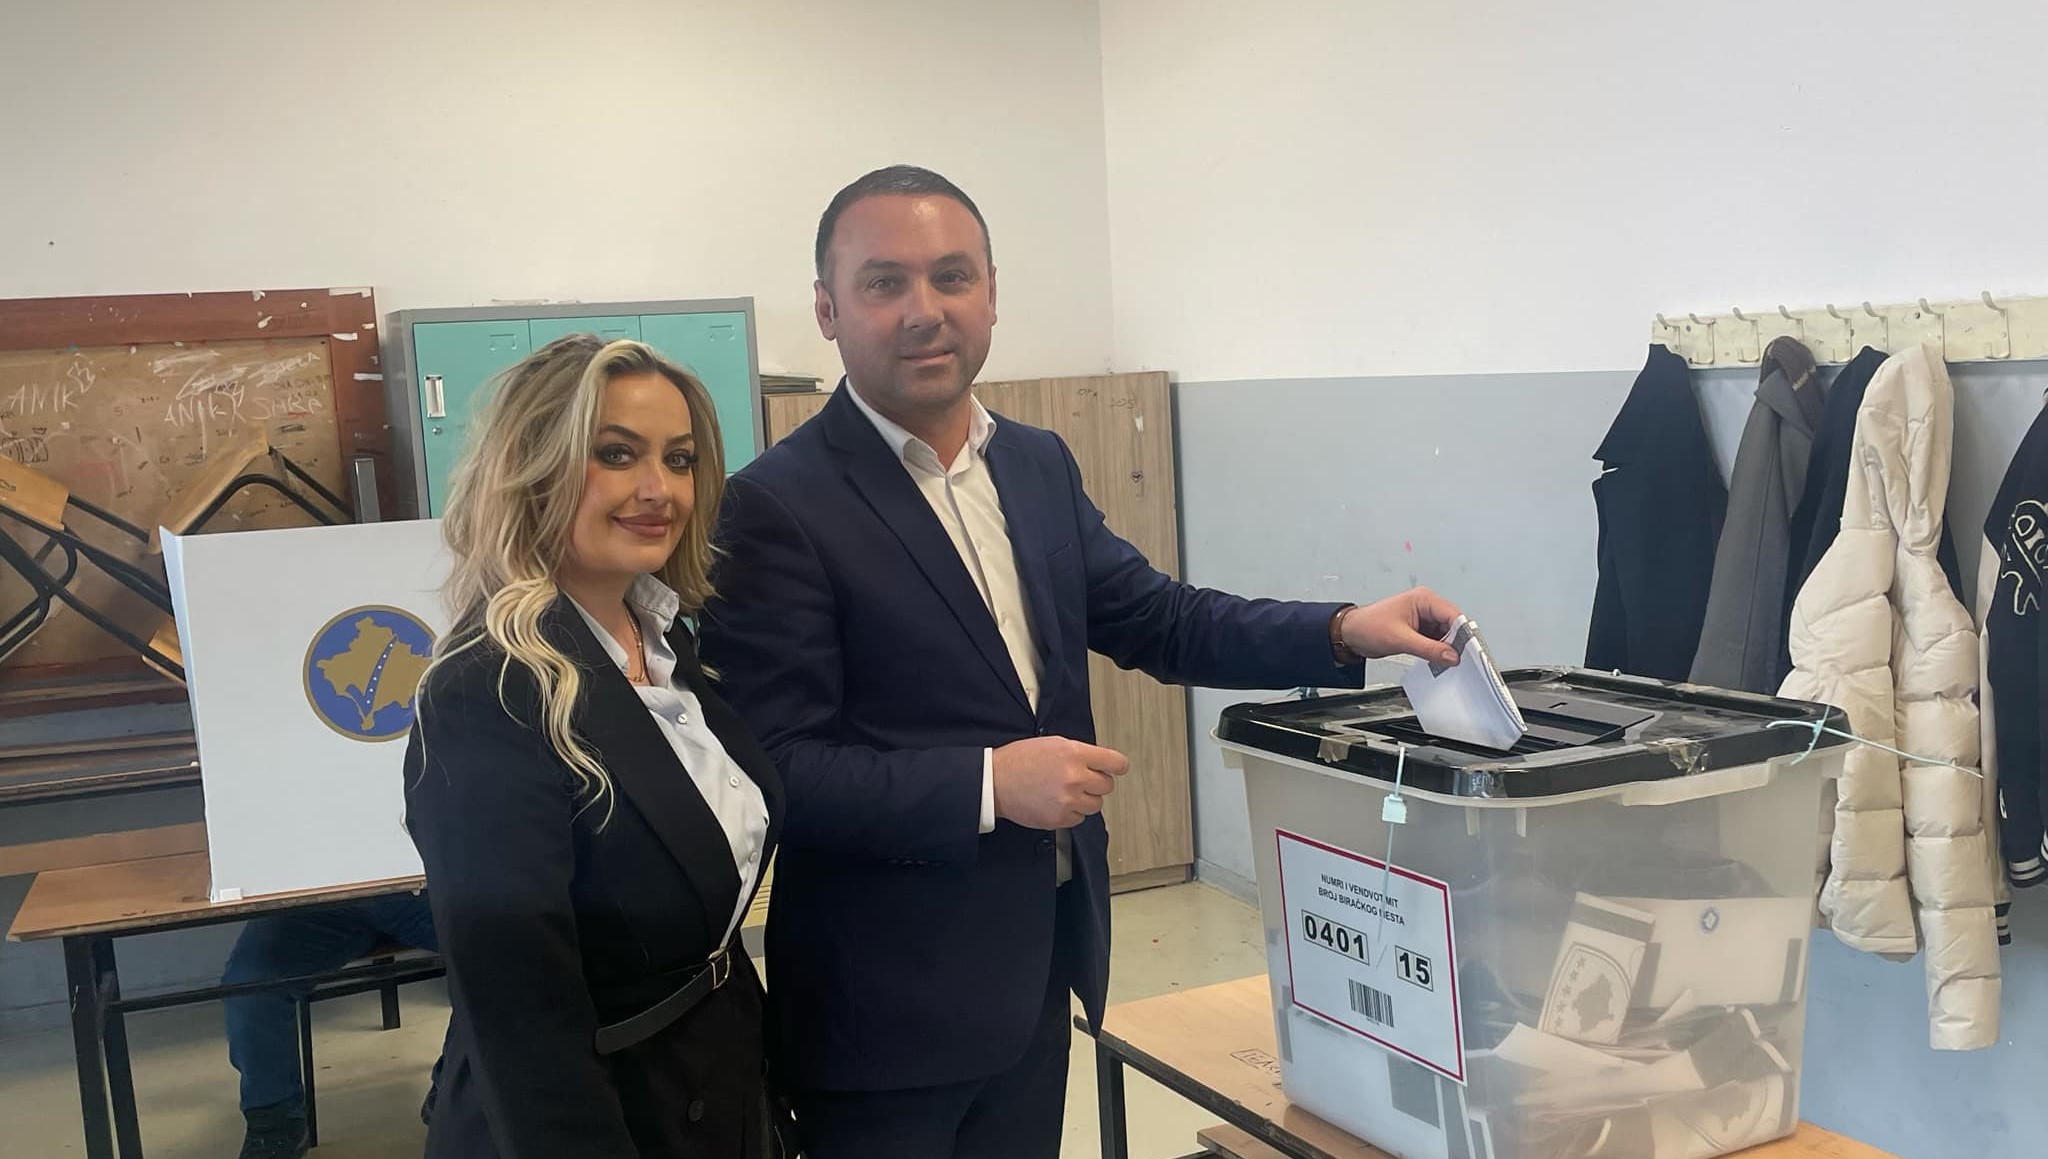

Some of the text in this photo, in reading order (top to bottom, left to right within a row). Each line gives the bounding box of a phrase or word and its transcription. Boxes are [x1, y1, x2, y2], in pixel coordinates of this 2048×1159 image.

[1318, 886, 1338, 901] BROJ
[1338, 893, 1378, 916] BIRAČKOG
[1321, 873, 1344, 889] NUMRI
[1348, 883, 1399, 908] VENDVOTMIT
[1304, 914, 1431, 985] 0401 15
